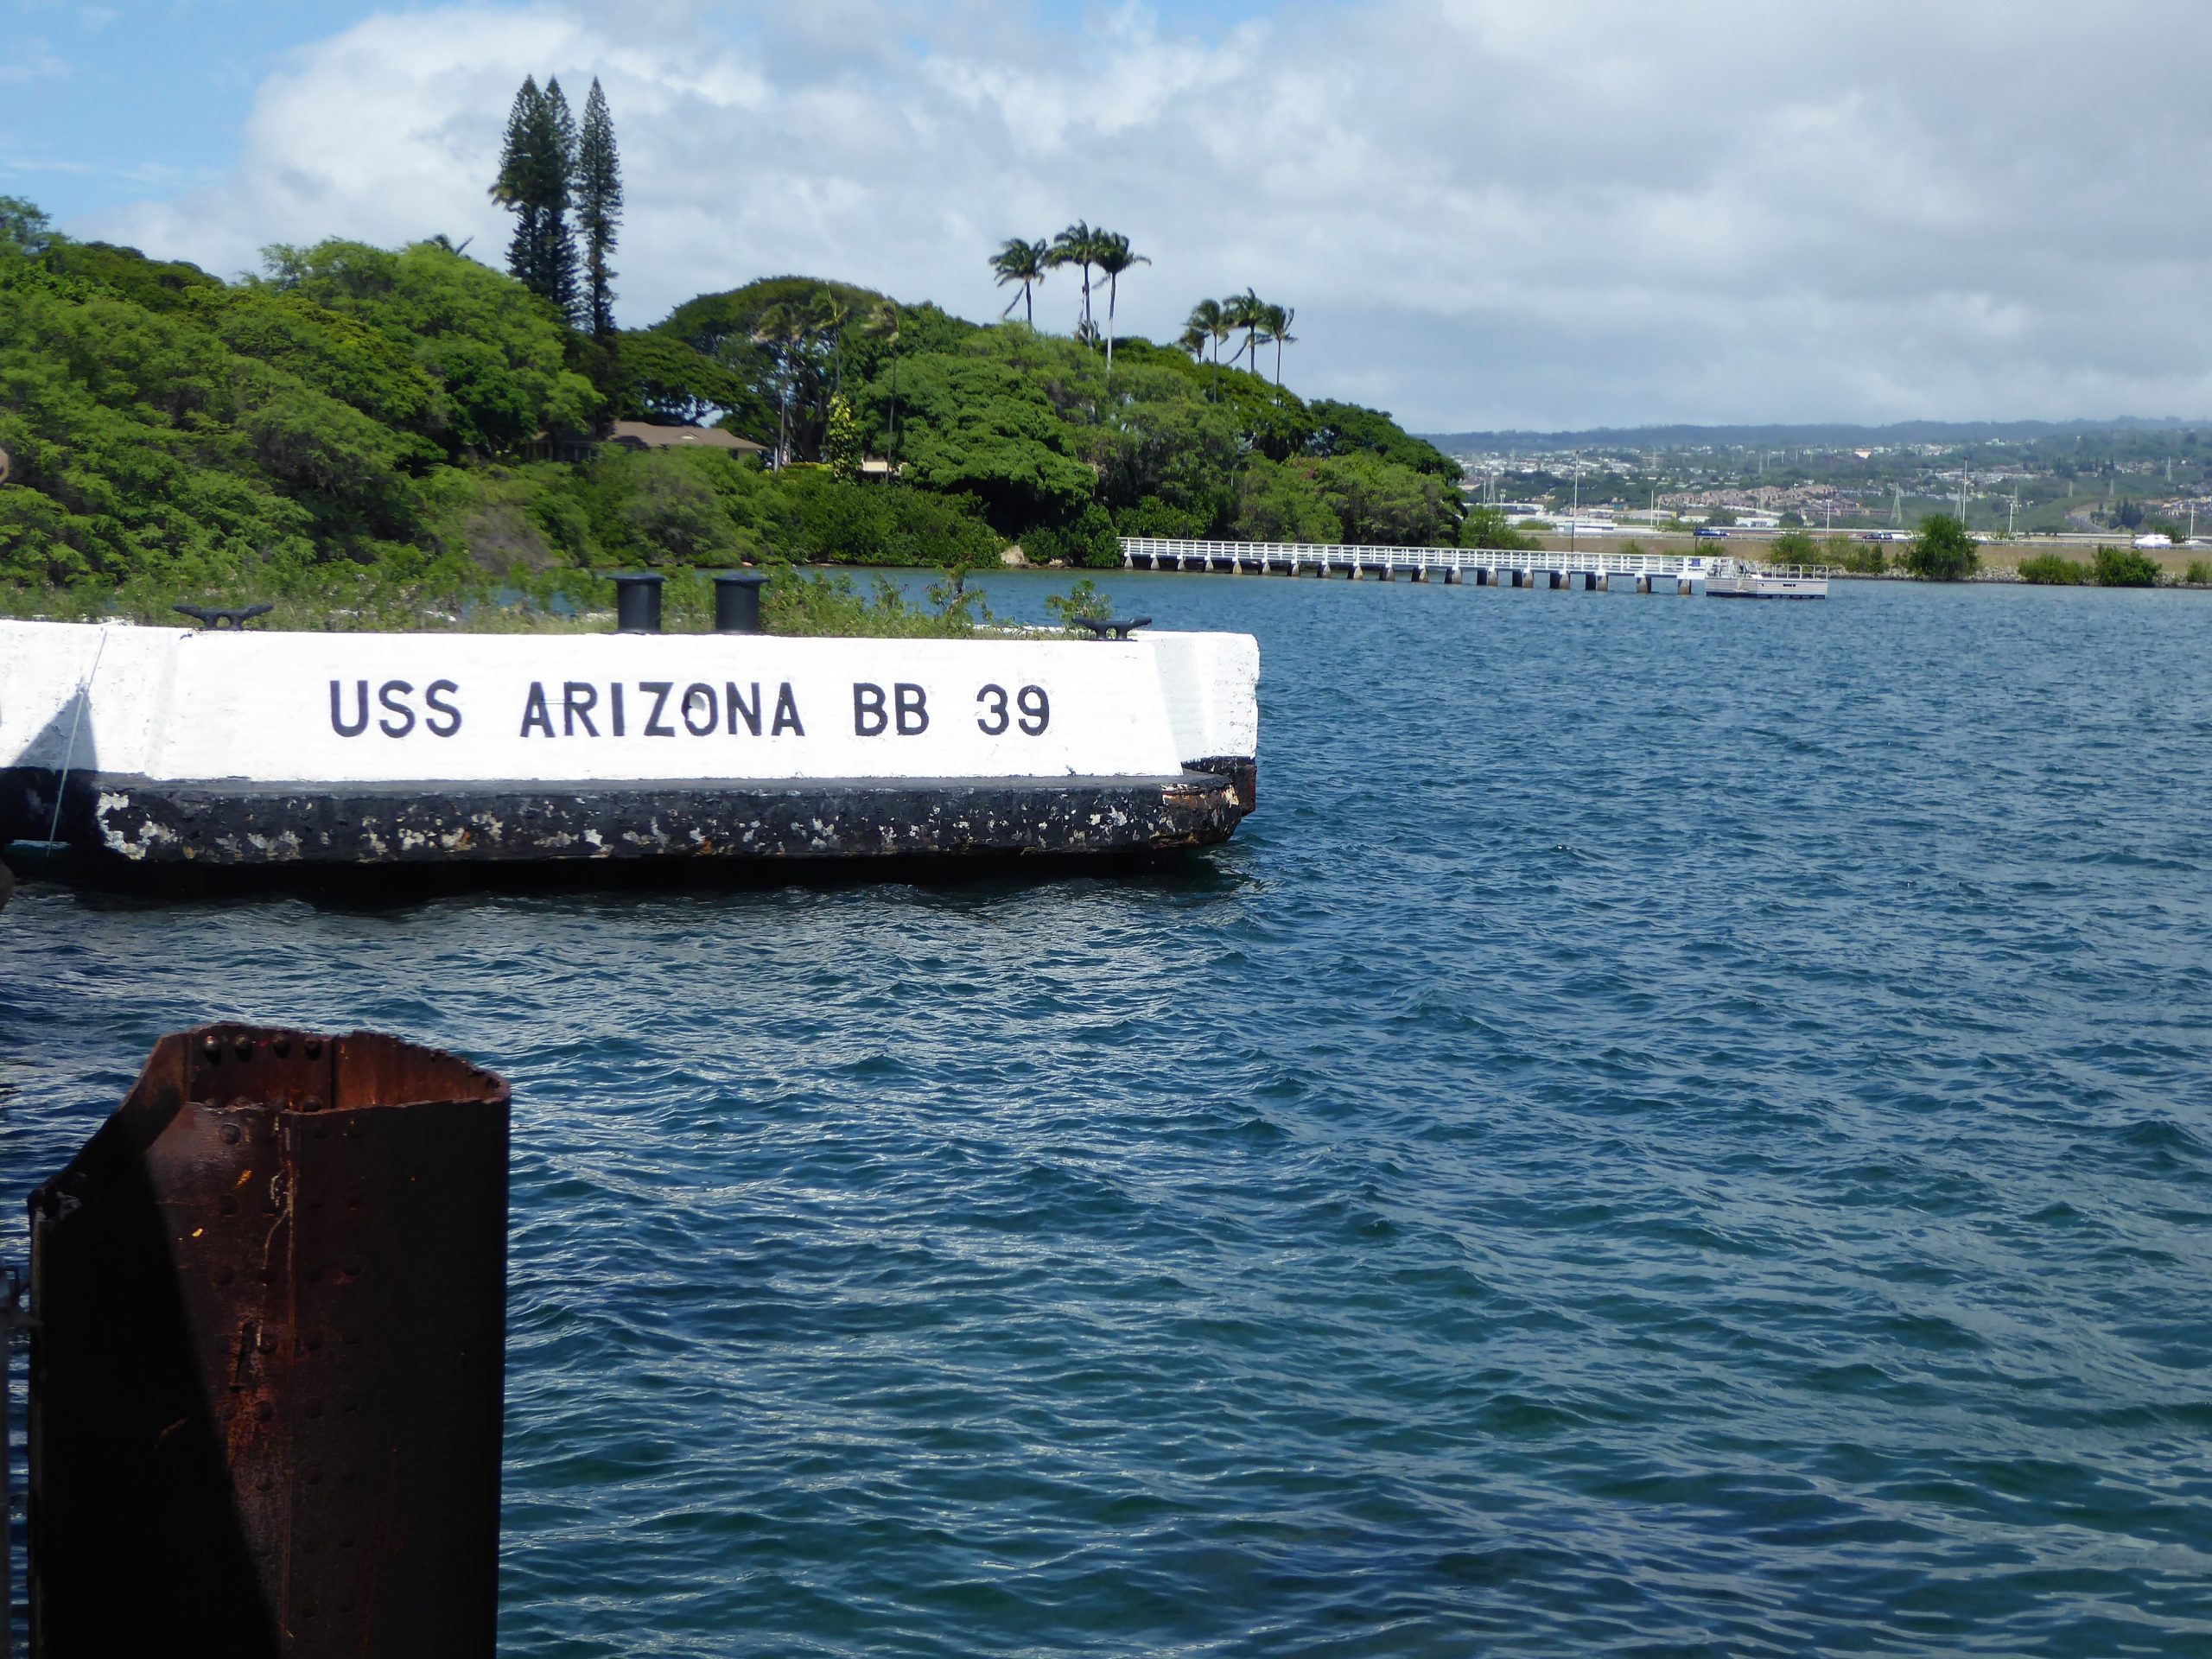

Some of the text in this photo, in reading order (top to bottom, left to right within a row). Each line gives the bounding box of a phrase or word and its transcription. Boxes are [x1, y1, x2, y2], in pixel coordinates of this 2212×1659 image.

[330, 680, 1051, 739] USS ARIZONA BB 39
